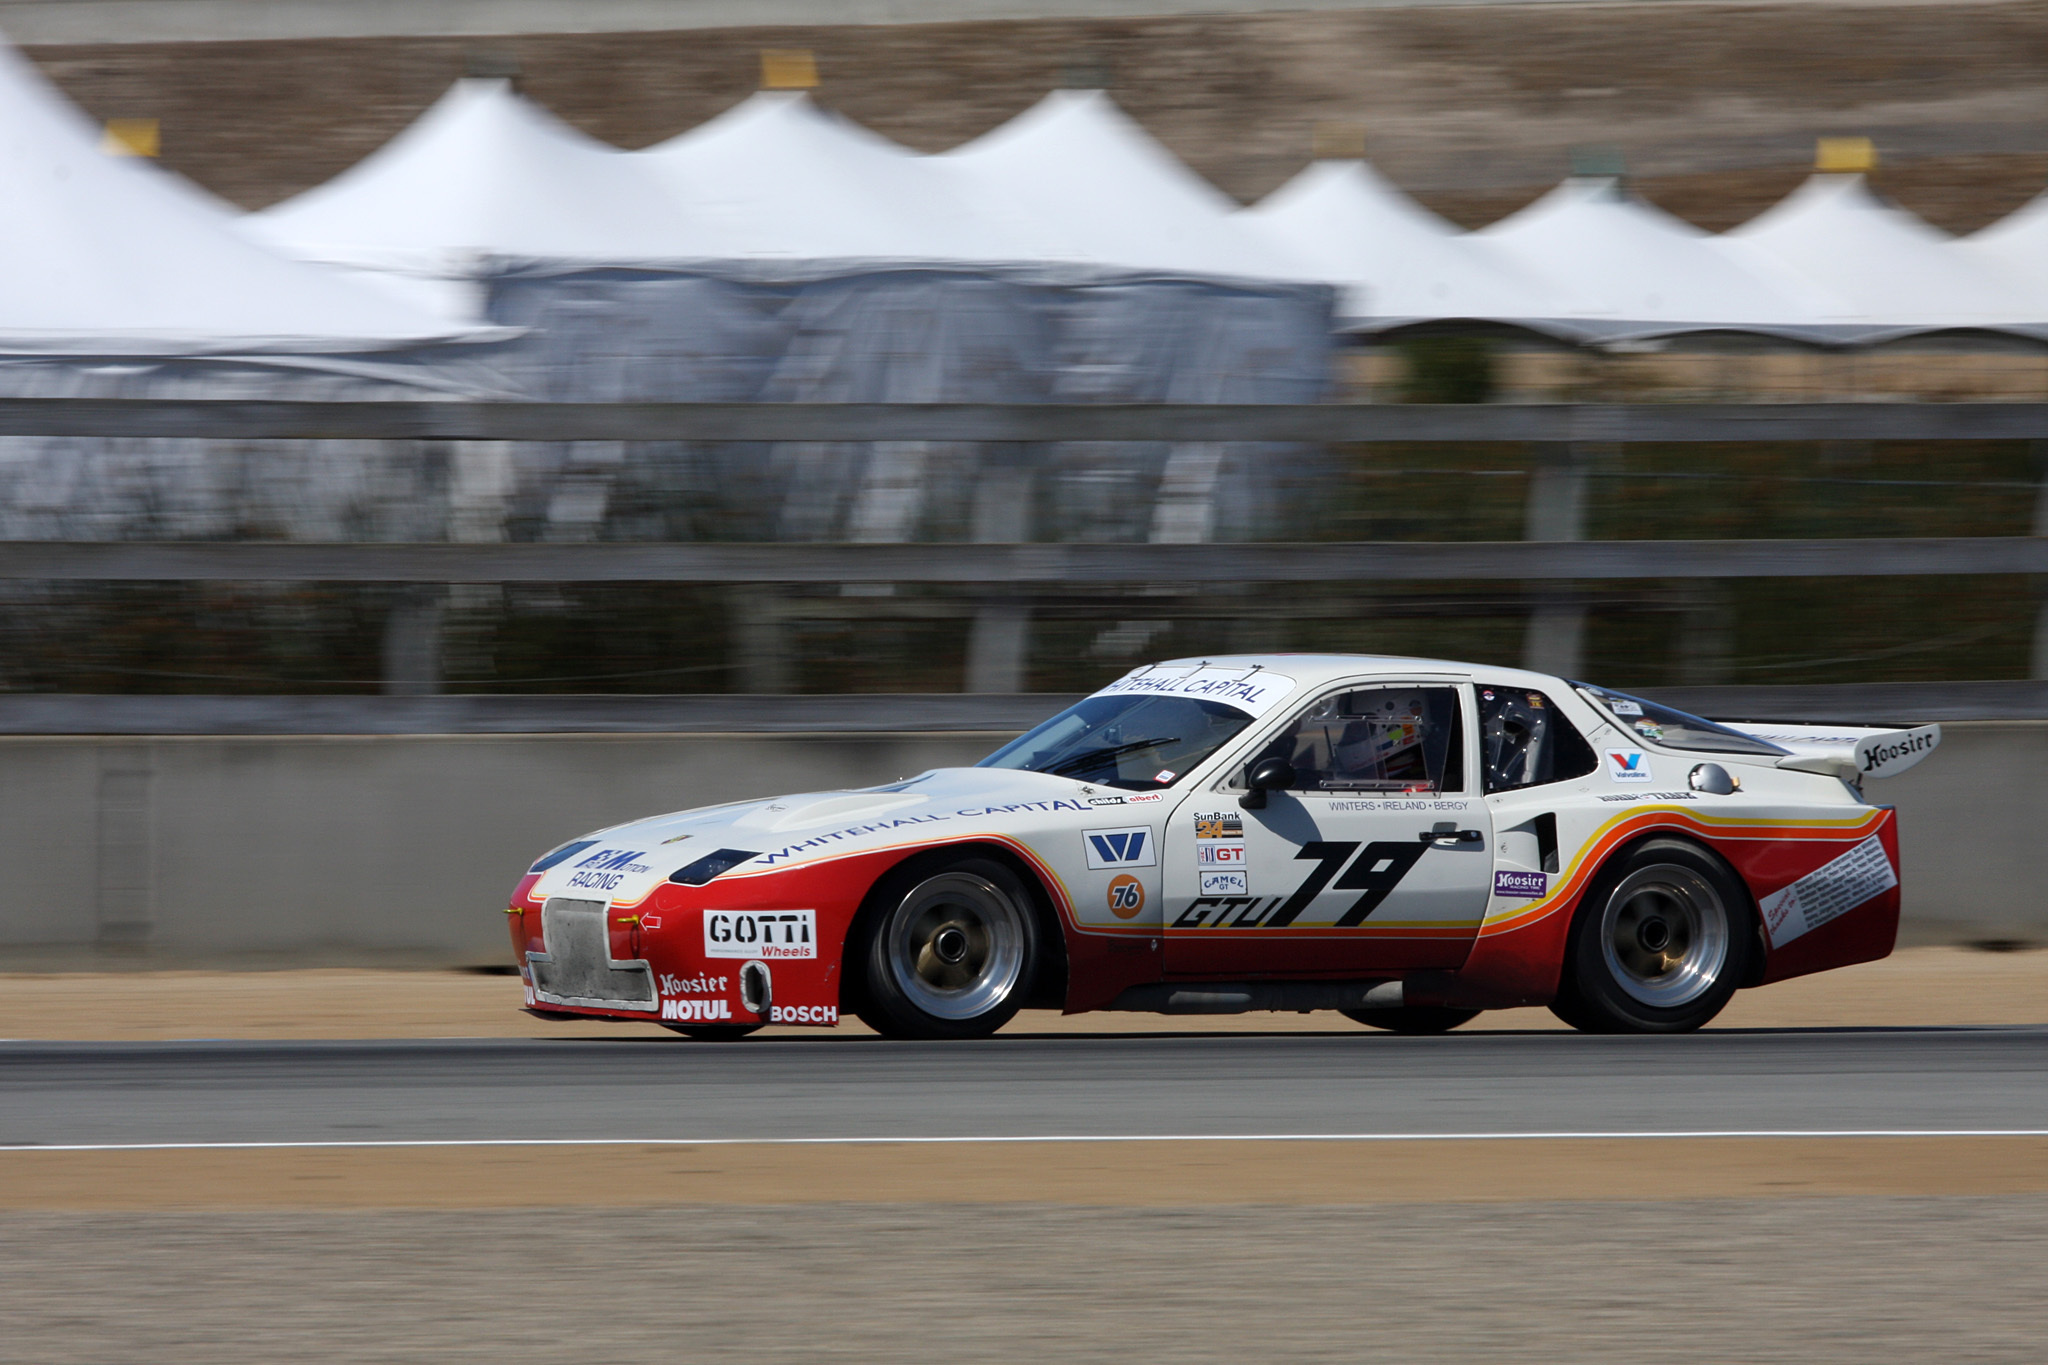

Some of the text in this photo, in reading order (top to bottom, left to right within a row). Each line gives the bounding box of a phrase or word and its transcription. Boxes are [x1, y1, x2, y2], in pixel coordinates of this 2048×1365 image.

[1183, 679, 1266, 703] CAPITAL
[1863, 733, 1933, 771] Hoosier
[1090, 794, 1160, 805] childs albert
[1329, 801, 1469, 811] WINTERS IRELAND BERGY
[1193, 812, 1240, 821] SunBank
[754, 799, 1094, 864] WHITEHALL CAPITAL
[1197, 821, 1223, 838] 24
[1216, 848, 1244, 861] GT
[566, 871, 625, 890] RACING
[1204, 875, 1244, 889] CAMEL
[1263, 841, 1434, 928] 79
[1496, 873, 1544, 887] Hoosier
[1112, 883, 1140, 909] 76
[1170, 897, 1284, 928] GTU
[761, 946, 811, 957] Wheels
[659, 971, 728, 996] Hoosier
[661, 999, 732, 1020] MOTUL
[770, 1005, 837, 1022] BOSCH
